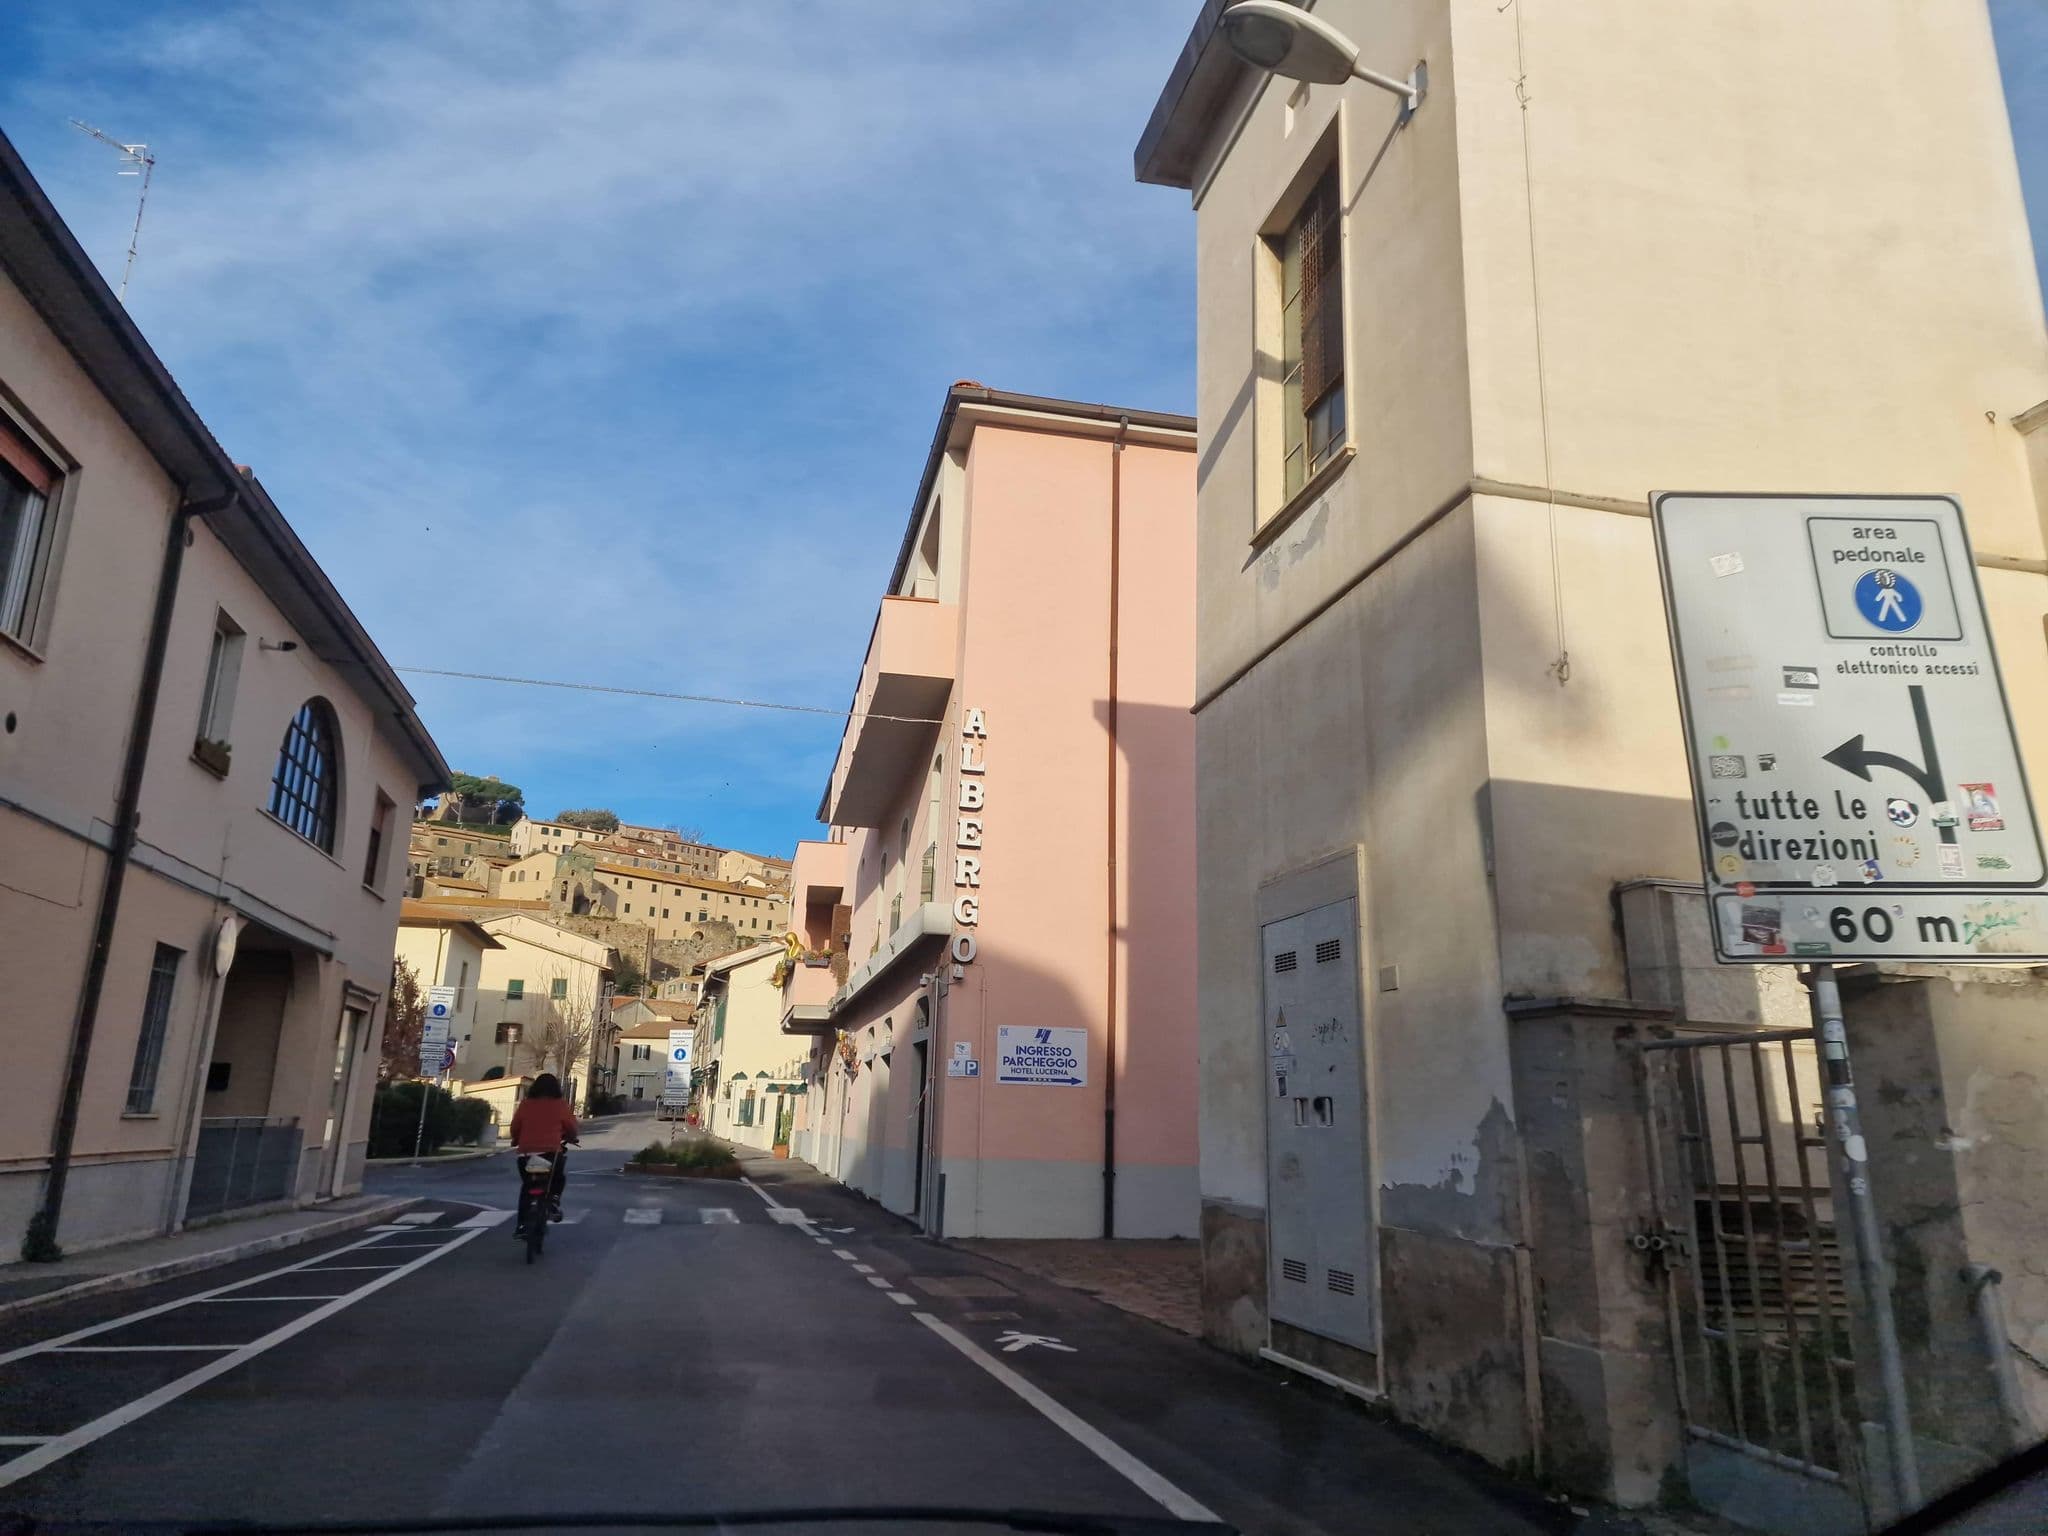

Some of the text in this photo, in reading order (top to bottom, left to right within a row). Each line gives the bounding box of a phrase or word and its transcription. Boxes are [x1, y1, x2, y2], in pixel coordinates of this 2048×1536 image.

[1852, 526, 1897, 540] area
[1833, 546, 1926, 564] pedonale
[1870, 644, 1938, 657] controllo
[1836, 660, 1979, 676] elettronico accessi
[1735, 789, 1868, 820] tutte le
[951, 707, 988, 964] ALBERGO
[1738, 829, 1880, 861] direzioni
[1829, 905, 1894, 944] 60
[1916, 915, 1959, 943] m
[1015, 1045, 1072, 1057] INGRESSO
[967, 1061, 977, 1074] P
[1002, 1056, 1078, 1068] PARCHEGGIO
[1010, 1067, 1069, 1076] HOTEL LUCERNA
